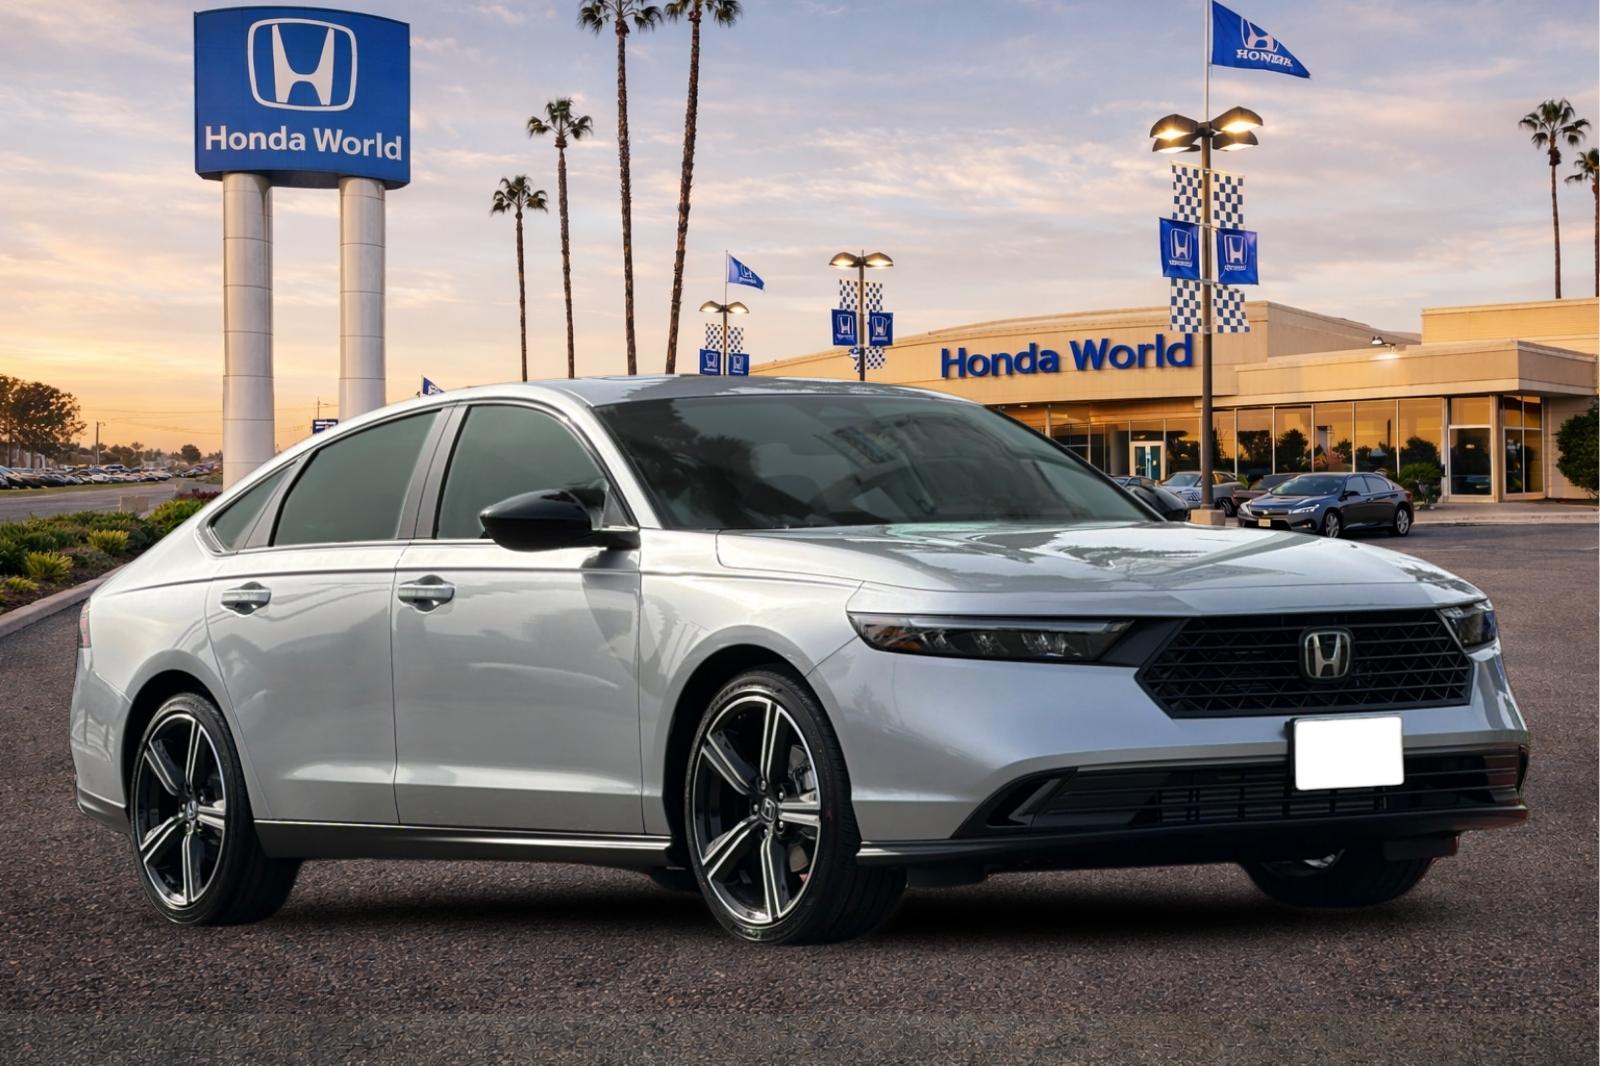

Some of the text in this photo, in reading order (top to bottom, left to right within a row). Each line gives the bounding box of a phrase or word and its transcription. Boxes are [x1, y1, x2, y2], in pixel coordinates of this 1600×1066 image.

[205, 125, 402, 161] Honda World
[940, 332, 1195, 379] Honda World
